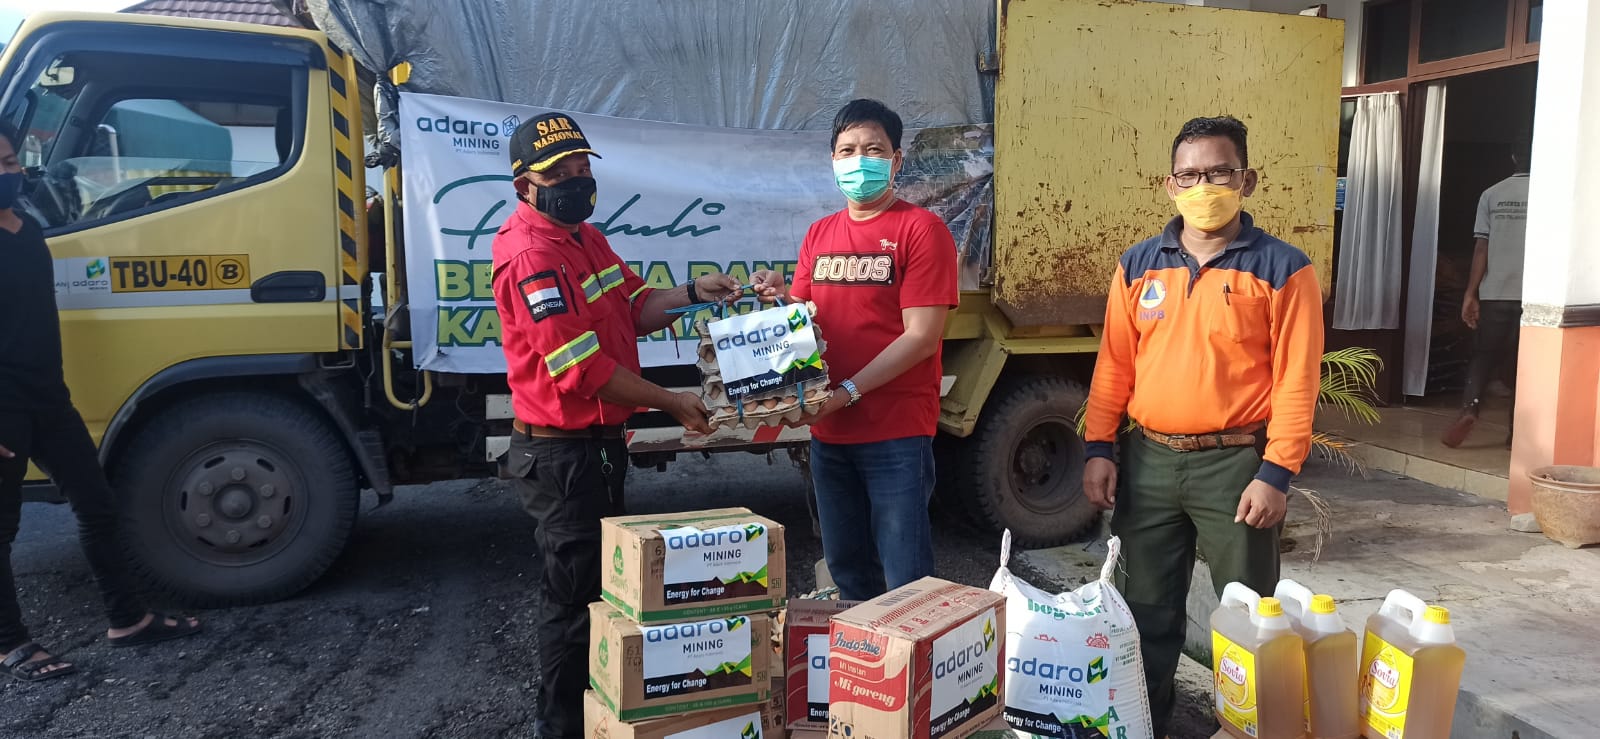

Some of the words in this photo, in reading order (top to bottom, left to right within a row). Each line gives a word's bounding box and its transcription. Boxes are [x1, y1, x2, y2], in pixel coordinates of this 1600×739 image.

[416, 115, 499, 136] adaro
[536, 117, 572, 136] SAR
[453, 137, 500, 149] MINING
[533, 131, 584, 151] NASIONAL
[113, 259, 208, 289] TBU-40
[221, 264, 238, 280] B
[717, 324, 787, 351] adaro
[752, 341, 790, 357] MINING
[728, 384, 751, 396] Energy
[750, 382, 759, 391] for
[759, 376, 783, 388] Change
[668, 530, 743, 550] adaro
[703, 549, 742, 562] MINING
[666, 588, 690, 600] Energy
[690, 587, 700, 597] for
[701, 586, 725, 597] Change
[646, 621, 724, 643] adaro
[683, 638, 724, 654] MINING
[834, 632, 881, 656] Indomie
[934, 640, 984, 680] adaro
[1008, 656, 1084, 683] adaro
[1222, 659, 1244, 682] Sovia
[958, 662, 984, 686] MINING
[1371, 661, 1396, 687] Sovia
[645, 682, 670, 695] Energy
[671, 680, 682, 690] for
[682, 678, 707, 689] Change
[834, 677, 853, 691] Mi
[852, 684, 896, 707] goreng
[1040, 684, 1083, 699] MINING
[810, 708, 829, 719] Energ
[931, 721, 947, 736] Energy
[954, 707, 970, 722] Change
[1003, 711, 1024, 727] Energy
[1024, 716, 1034, 727] for
[1035, 720, 1062, 734] Change
